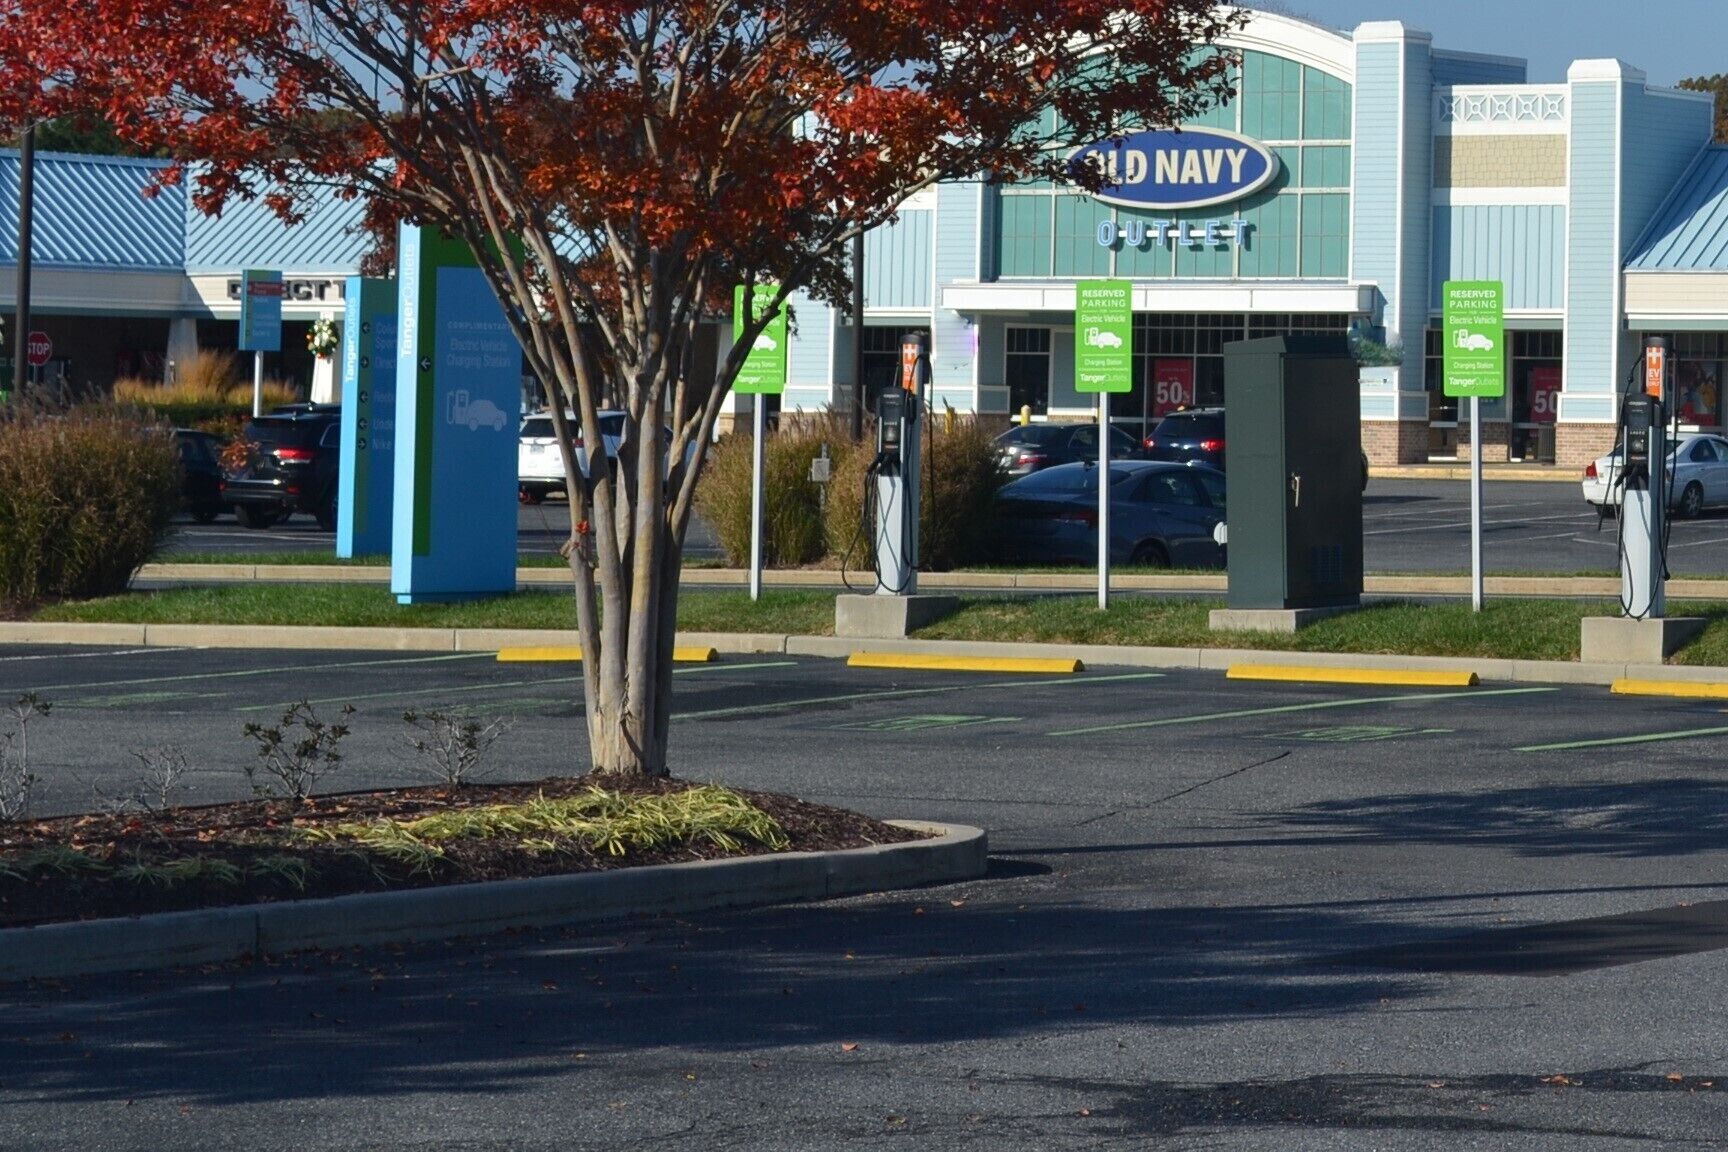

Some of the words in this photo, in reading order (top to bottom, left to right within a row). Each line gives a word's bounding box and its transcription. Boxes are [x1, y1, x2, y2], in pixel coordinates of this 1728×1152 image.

[1155, 148, 1249, 185] NAVY
[1097, 219, 1249, 248] OUTLET
[1082, 289, 1126, 297] RESERVED
[1450, 290, 1497, 298] RESERVED
[1082, 299, 1126, 308] PARKING
[1449, 300, 1497, 309] PARKING
